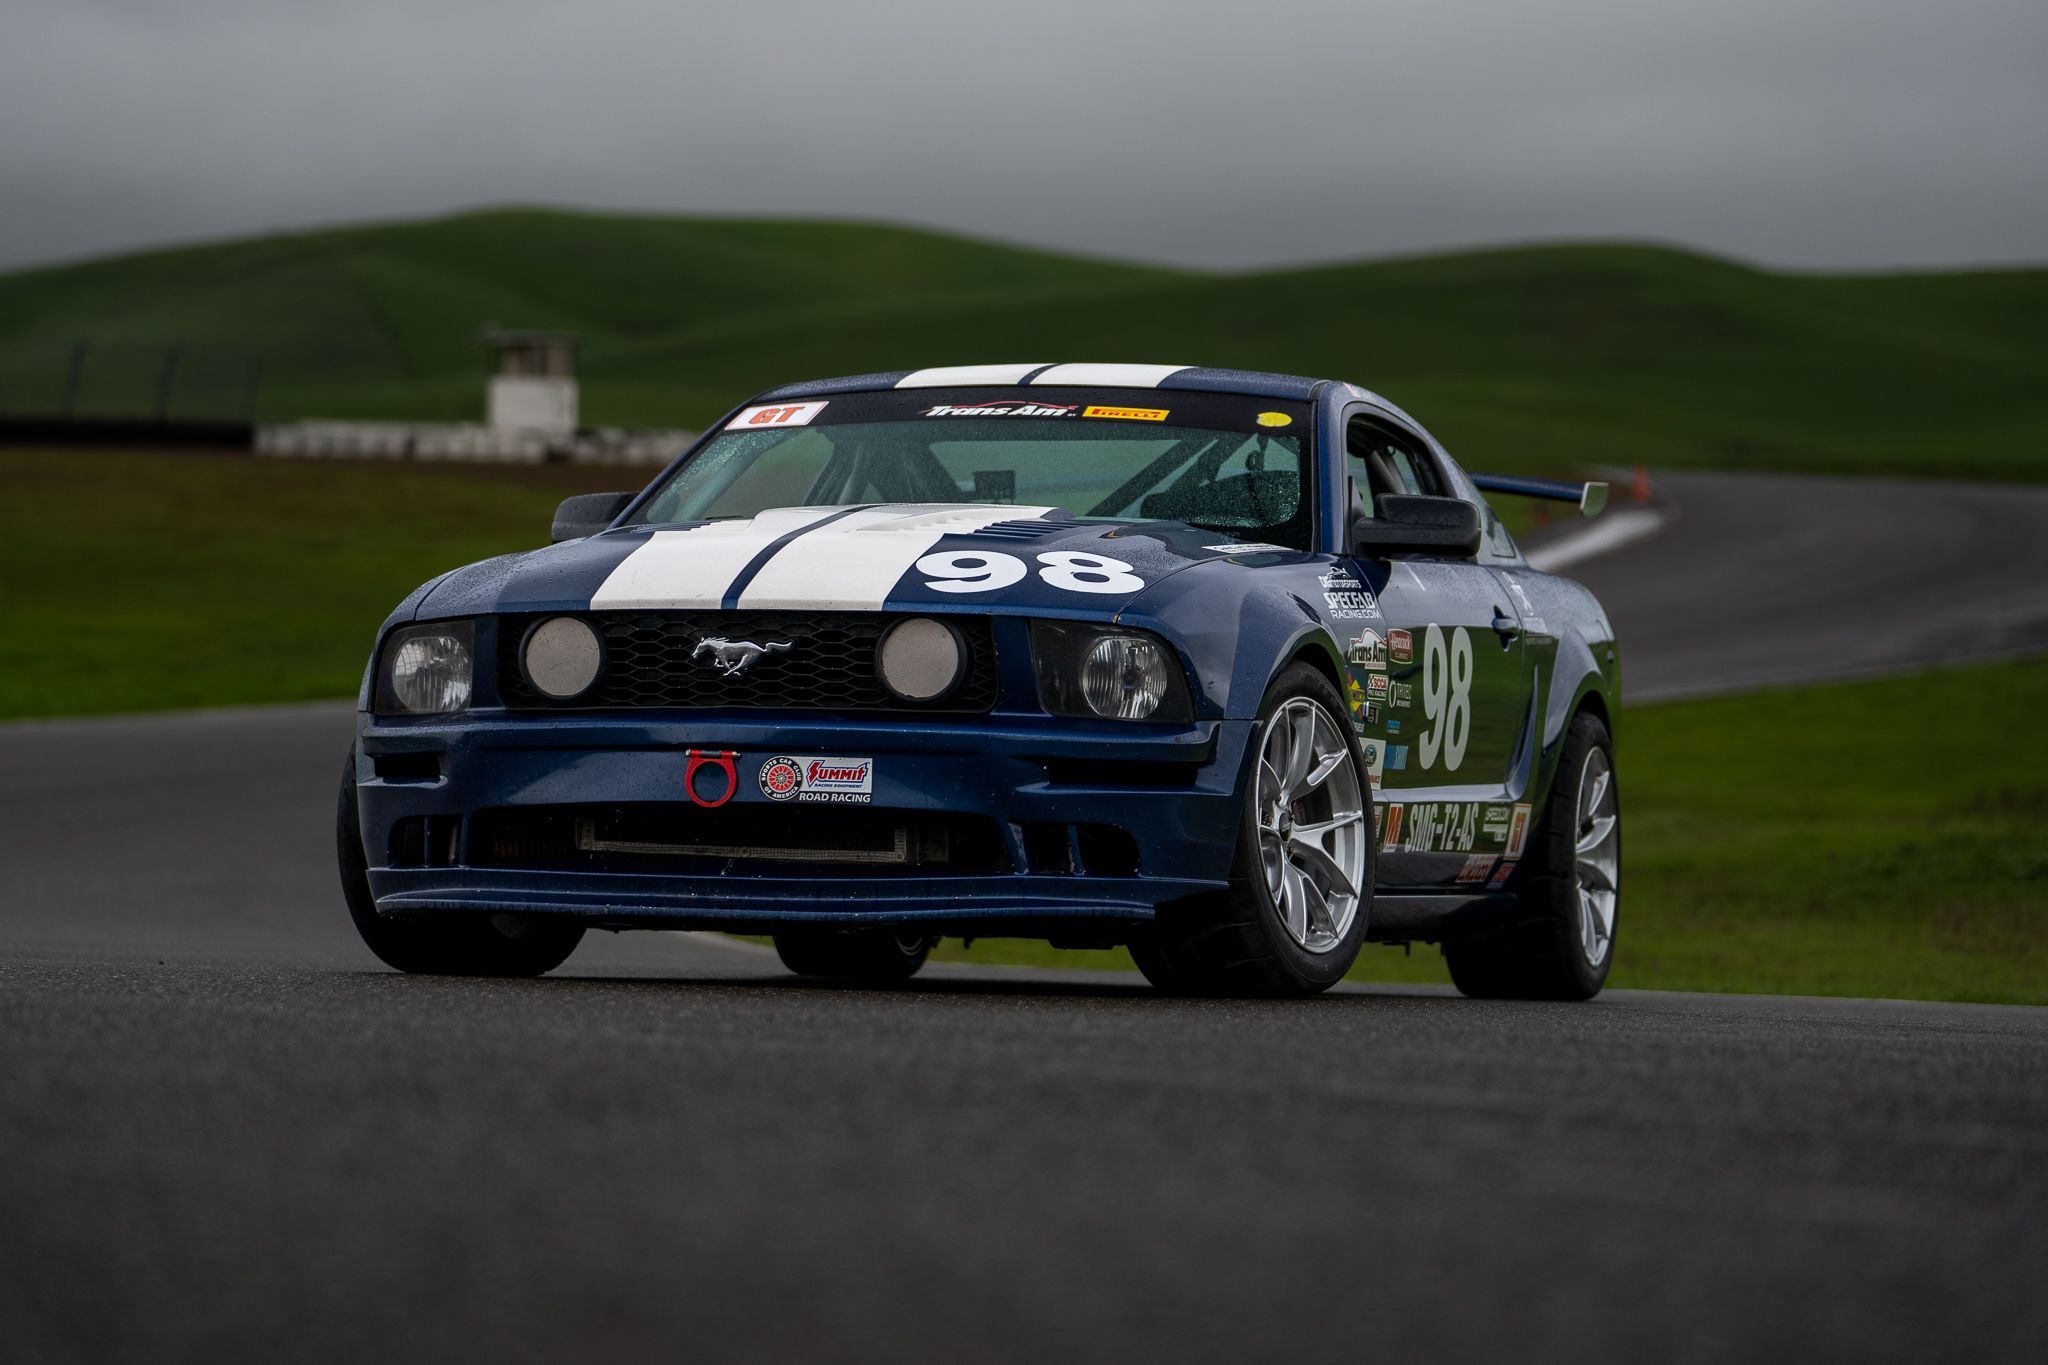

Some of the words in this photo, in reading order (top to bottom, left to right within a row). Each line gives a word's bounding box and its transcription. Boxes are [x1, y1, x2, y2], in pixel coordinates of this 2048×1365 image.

[748, 406, 806, 425] GT
[926, 405, 1012, 417] Trans
[1007, 405, 1068, 417] Am
[1092, 408, 1161, 419] PIRELLI
[915, 550, 1145, 594] 98
[1323, 591, 1376, 609] SPECFAB
[1330, 609, 1382, 619] RACING.COM
[1348, 643, 1373, 663] Trans
[1372, 640, 1387, 663] Am
[1374, 677, 1387, 689] SCCA
[1419, 622, 1473, 771] 98
[761, 760, 777, 781] SPORTS
[793, 765, 802, 781] CLUB
[764, 786, 773, 795] OF
[772, 786, 799, 799] AMERICA
[799, 792, 830, 801] ROAD
[831, 793, 871, 803] RACING
[1404, 802, 1480, 853] SMG-T2-AS
